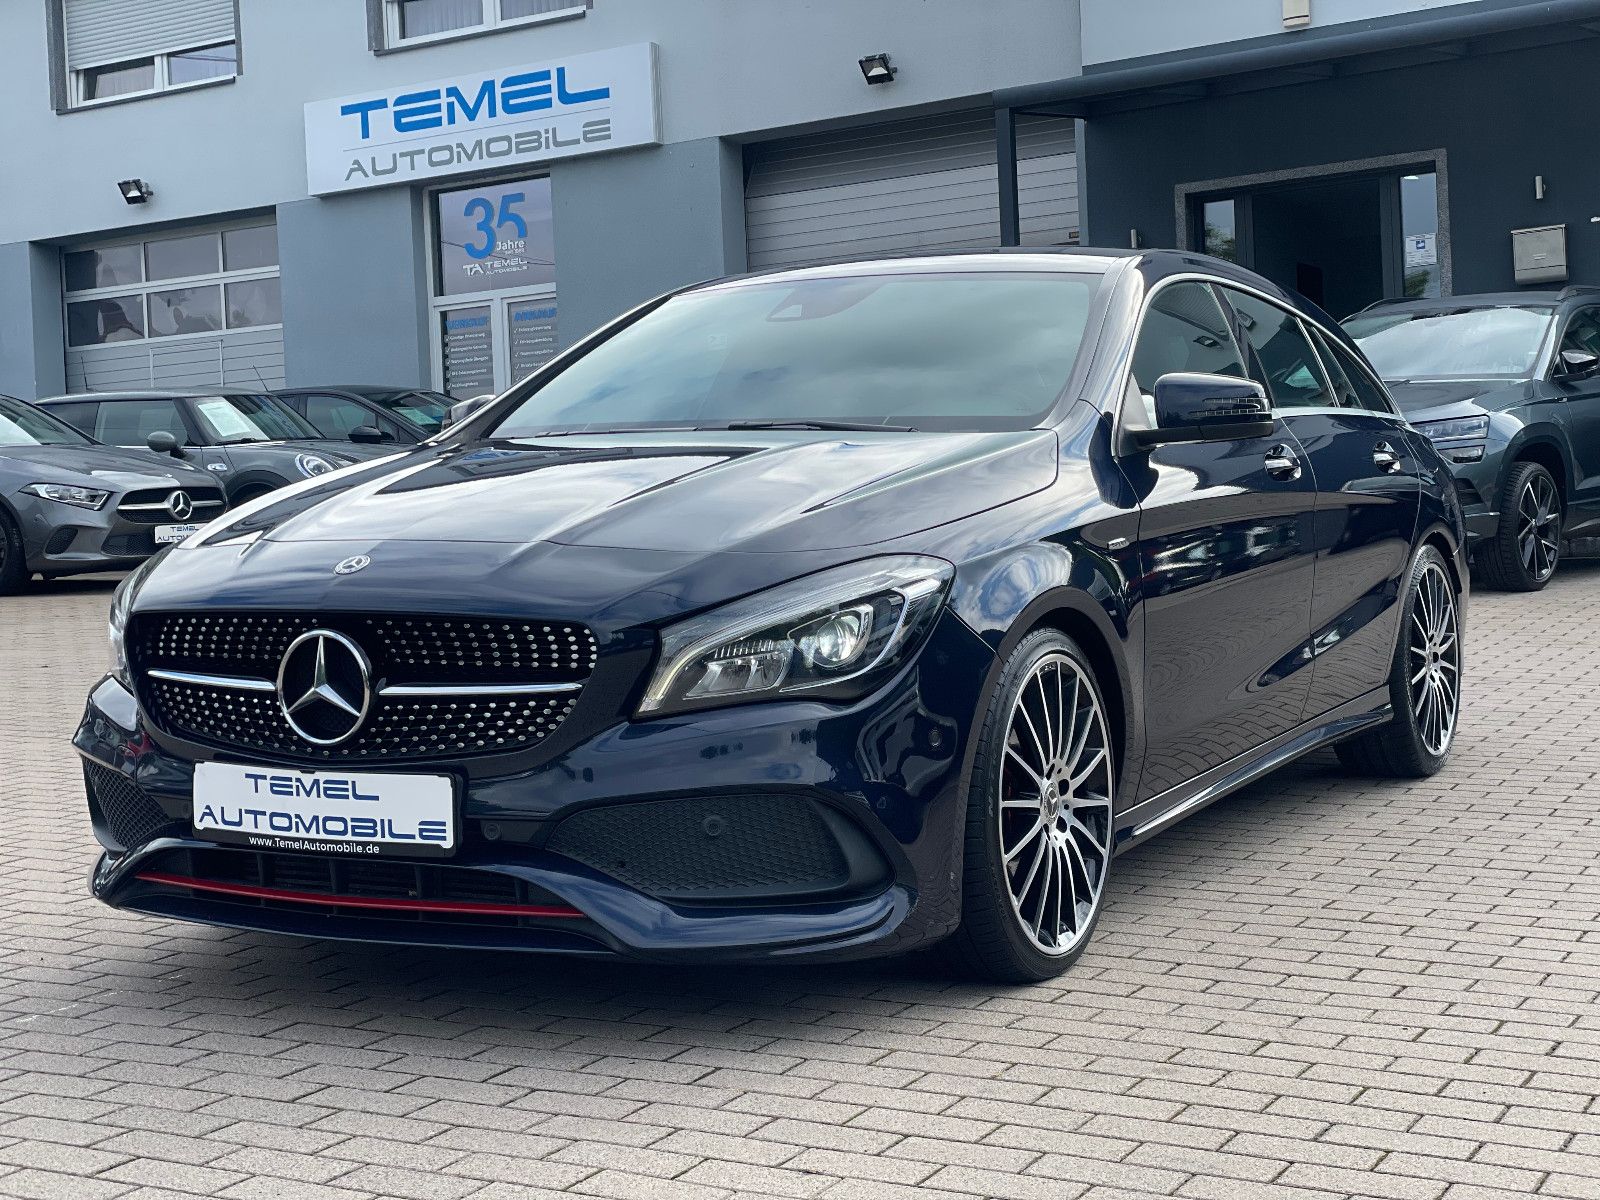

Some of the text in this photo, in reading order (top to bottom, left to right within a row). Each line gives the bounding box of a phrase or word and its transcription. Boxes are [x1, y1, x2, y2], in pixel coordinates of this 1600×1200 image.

[340, 66, 611, 140] TEMEL
[463, 192, 528, 260] 35
[496, 239, 525, 251] Jahre
[463, 263, 484, 277] TA
[485, 257, 528, 269] TEMEL
[244, 773, 379, 801] TEMEL
[199, 805, 447, 841] AUTOMOBILE
[249, 836, 379, 854] www.TemelAutomobile.de
